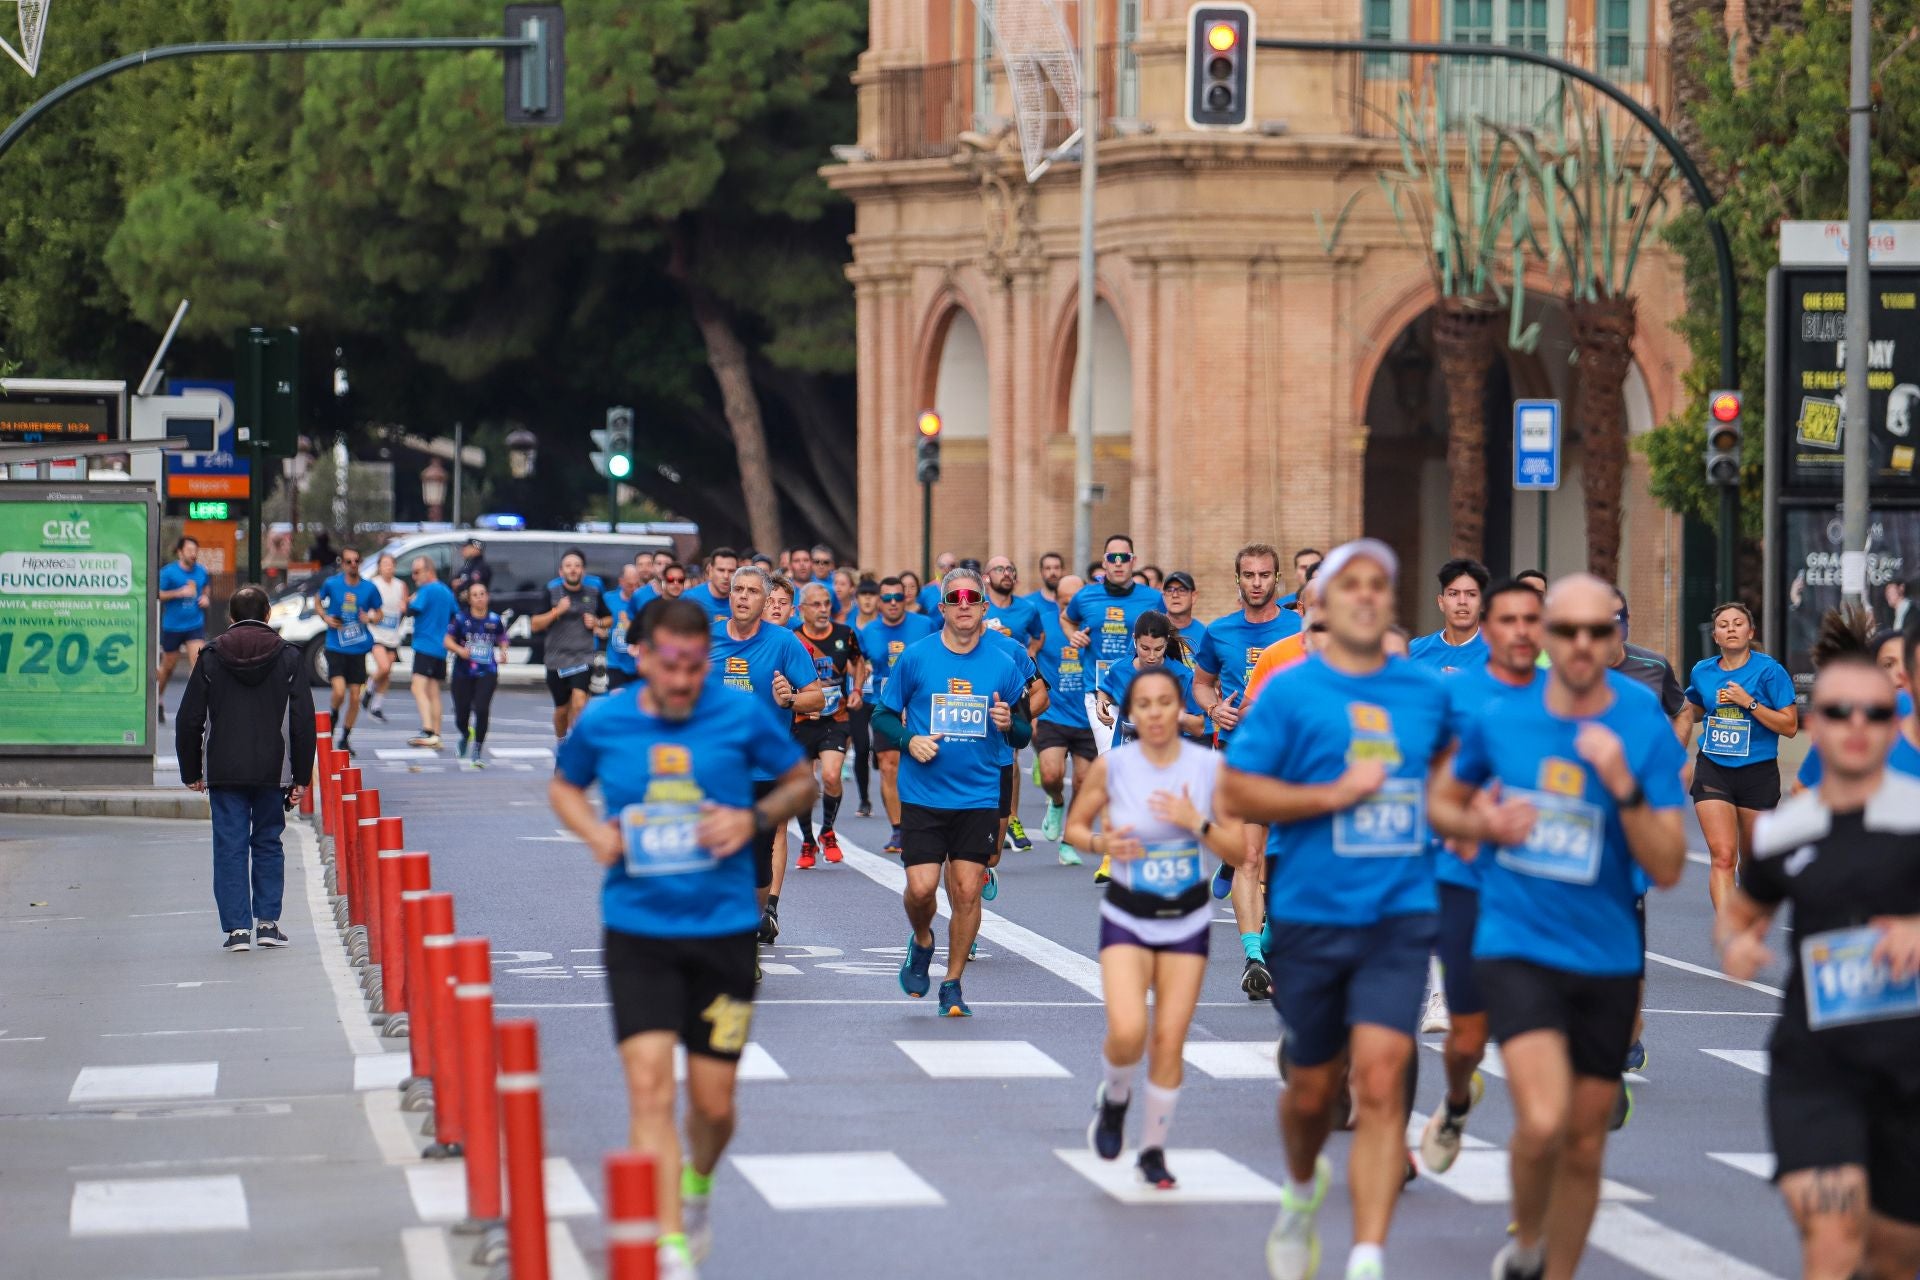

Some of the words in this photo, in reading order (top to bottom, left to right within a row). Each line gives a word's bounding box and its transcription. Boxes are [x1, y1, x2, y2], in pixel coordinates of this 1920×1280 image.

[1801, 311, 1847, 341] BLAC
[1836, 340, 1895, 369] FDAY
[189, 502, 228, 520] LIBRE
[43, 520, 91, 539] CRC
[80, 560, 118, 570] VERDE
[1, 573, 129, 588] FUNCIONARIOS
[103, 601, 130, 610] GANA
[19, 617, 54, 627] INVITA
[938, 707, 982, 724] 1190
[1711, 729, 1740, 745] 960
[1142, 857, 1192, 881] 035
